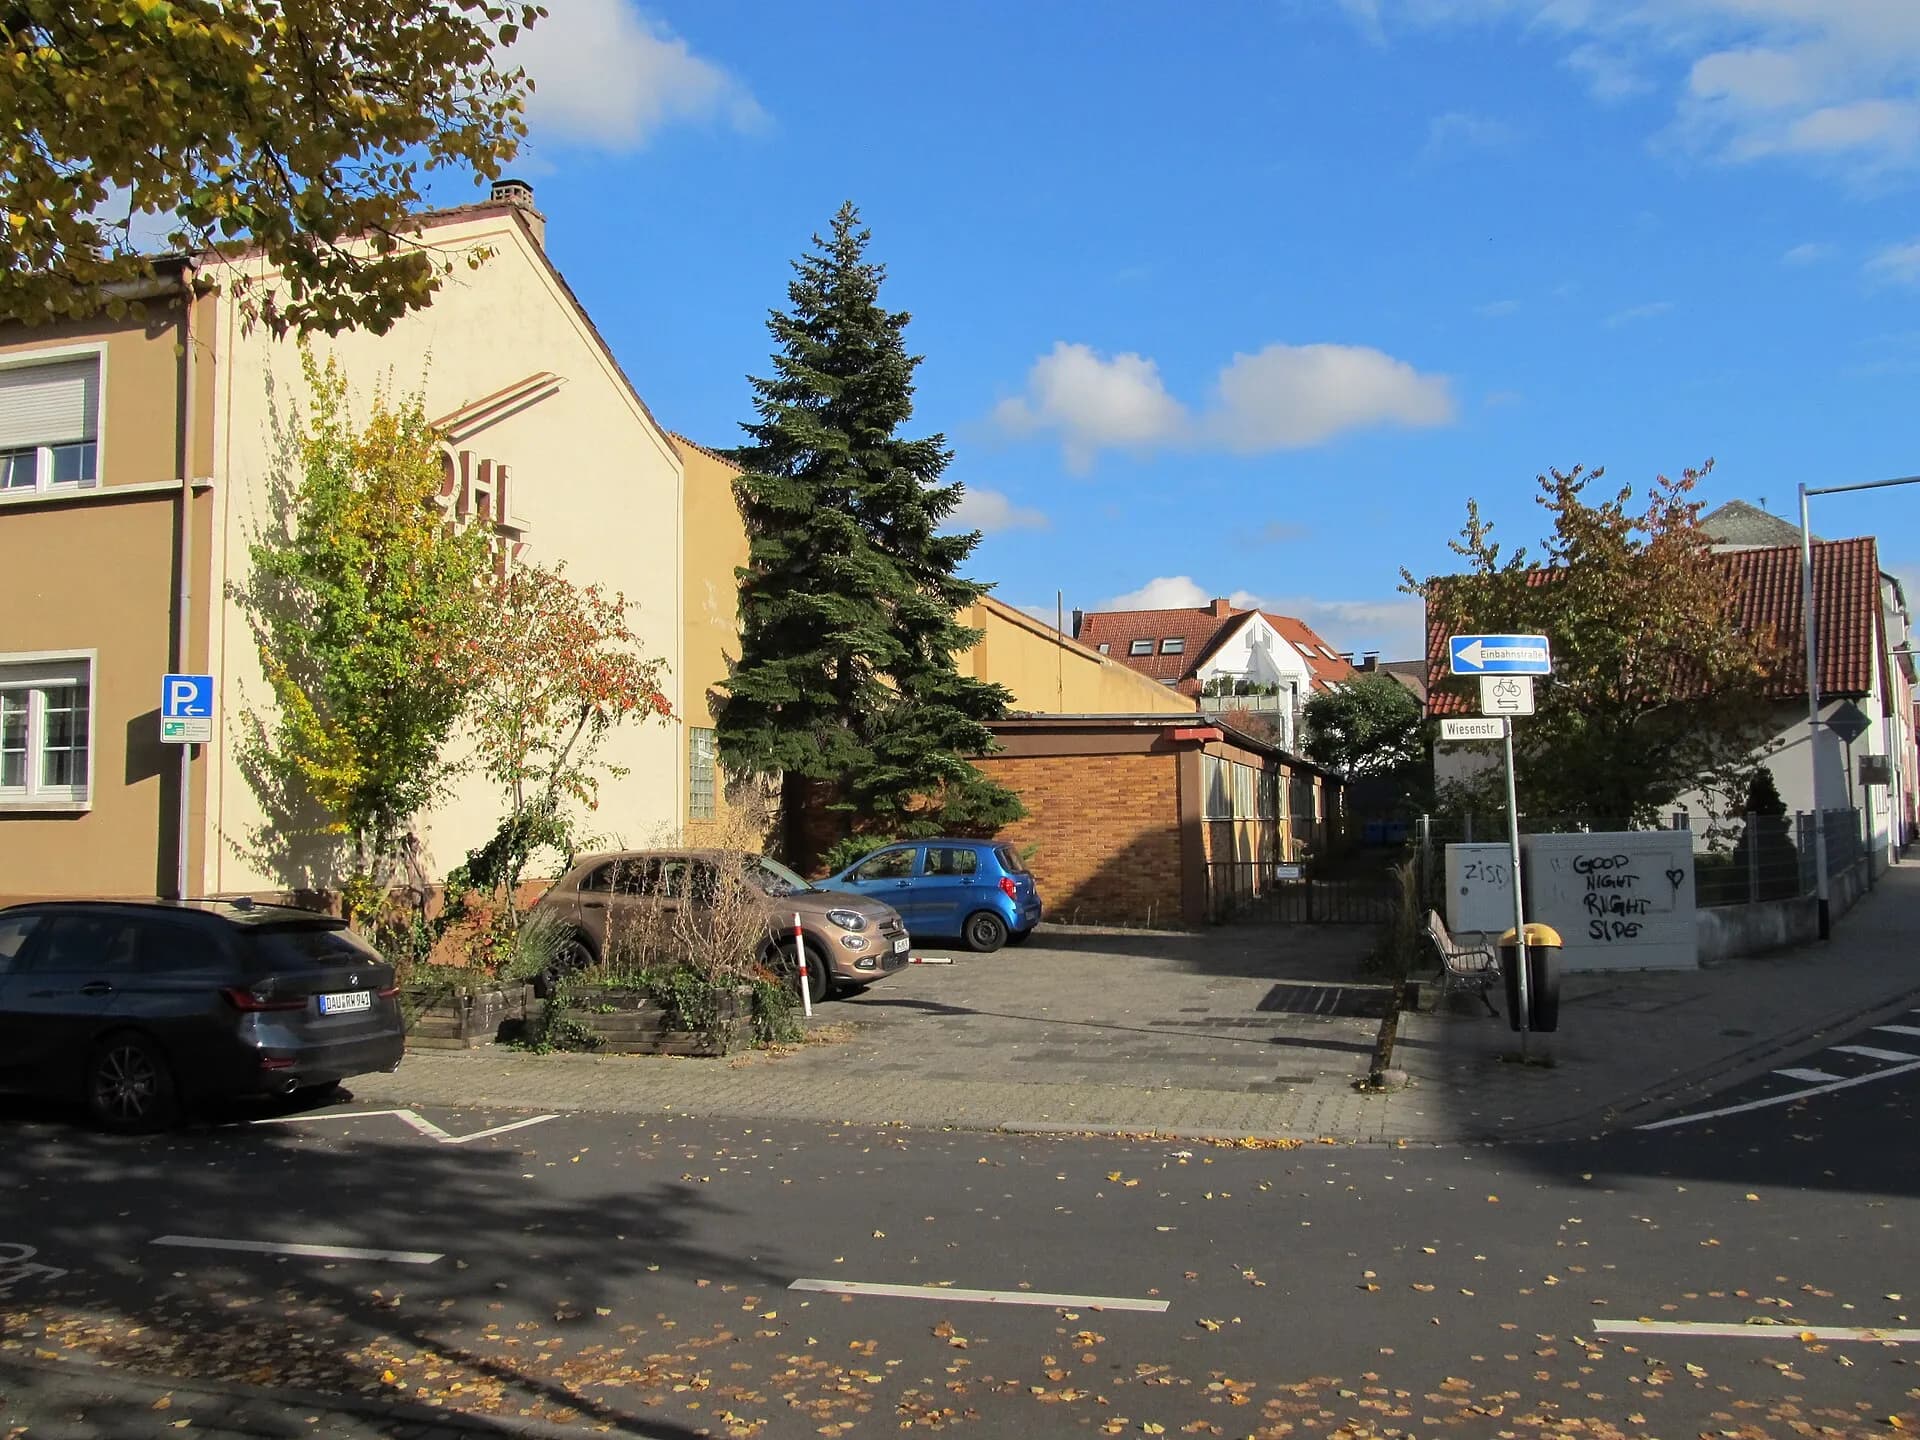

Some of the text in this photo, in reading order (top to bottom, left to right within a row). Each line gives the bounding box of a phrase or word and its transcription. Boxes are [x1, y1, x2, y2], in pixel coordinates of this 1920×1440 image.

[1481, 650, 1543, 659] Einbahnstraße
[171, 681, 198, 715] P
[1447, 723, 1497, 735] Wiesenstr.
[1573, 855, 1629, 874] GOOD
[1586, 874, 1640, 890] NIGHT
[1583, 893, 1651, 917] RIGHT
[1589, 920, 1643, 941] SIDE
